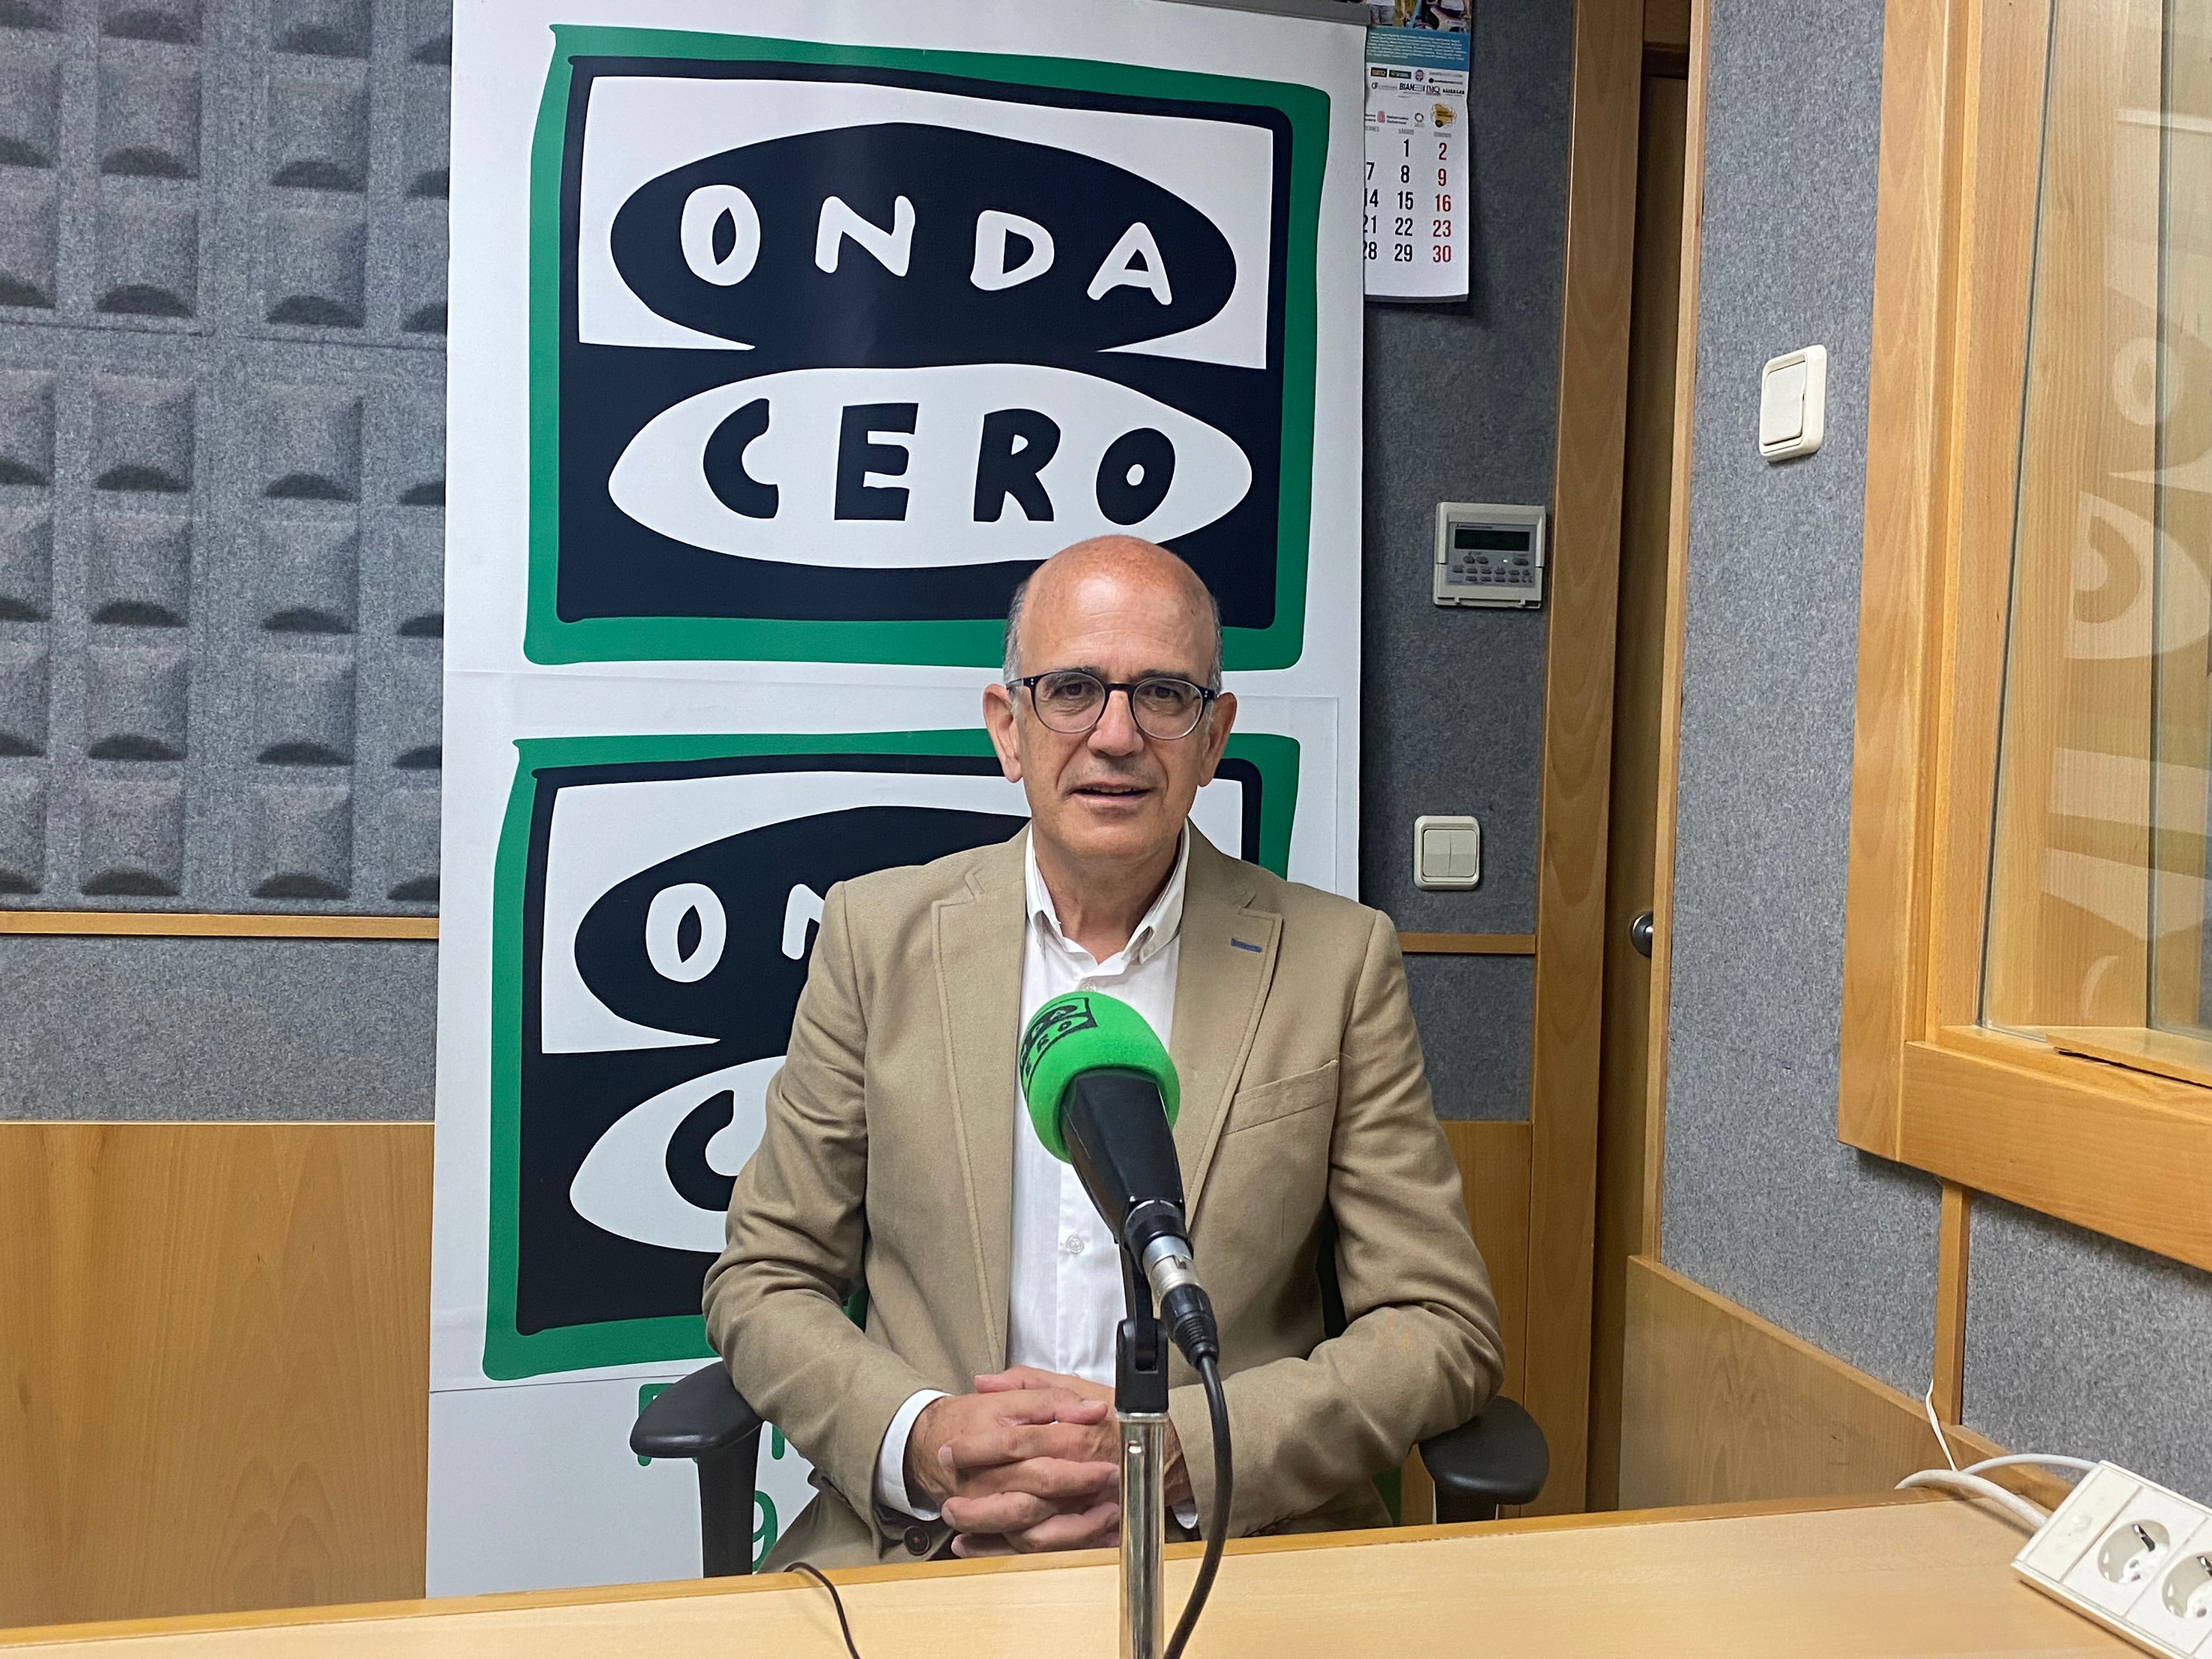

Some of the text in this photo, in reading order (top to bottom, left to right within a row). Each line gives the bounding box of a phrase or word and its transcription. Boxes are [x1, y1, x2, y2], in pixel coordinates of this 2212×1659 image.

[1403, 138, 1447, 161] 1 2
[1366, 162, 1447, 187] 7 8 9
[1397, 190, 1414, 210] 15
[1435, 194, 1451, 212] 16
[1395, 217, 1413, 236] 22
[1432, 219, 1452, 238] 23
[681, 185, 1172, 305] ONDA
[1394, 243, 1413, 262] 29
[1432, 245, 1451, 263] 30
[703, 398, 1175, 525] CERO
